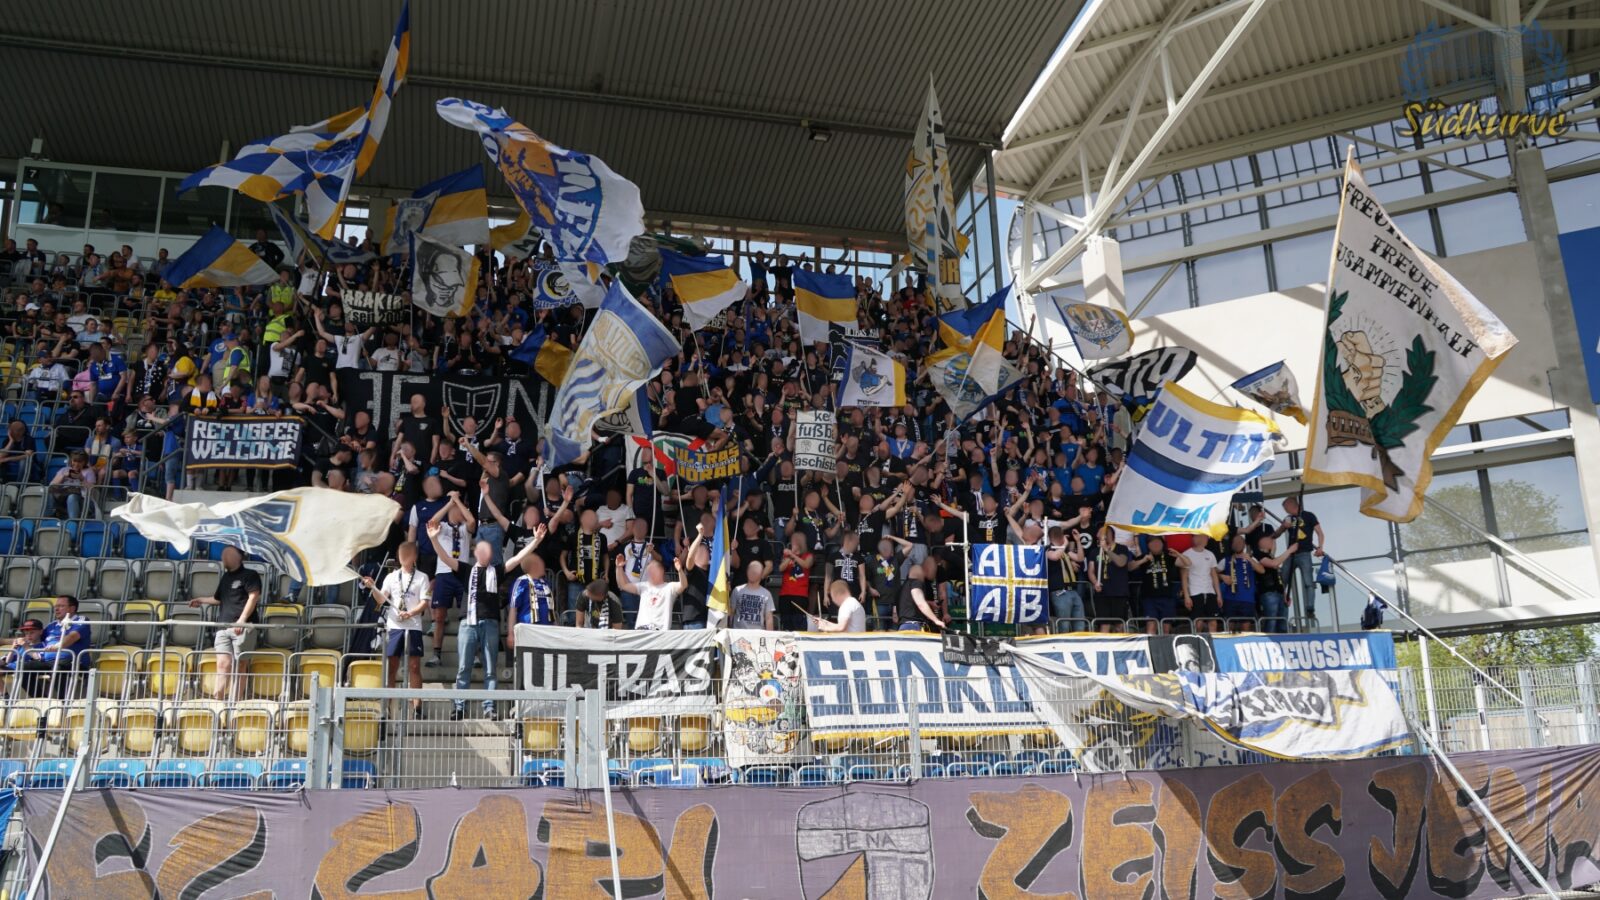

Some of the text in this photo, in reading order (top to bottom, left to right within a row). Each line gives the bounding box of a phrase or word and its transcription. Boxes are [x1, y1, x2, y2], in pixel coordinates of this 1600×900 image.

[1369, 234, 1439, 299] TREUE
[192, 420, 299, 441] REFUGEES
[191, 440, 297, 460] WELCOME
[1234, 638, 1372, 671] UNBEUGSAM
[522, 651, 714, 698] ULTRAS
[832, 832, 898, 852] JENA
